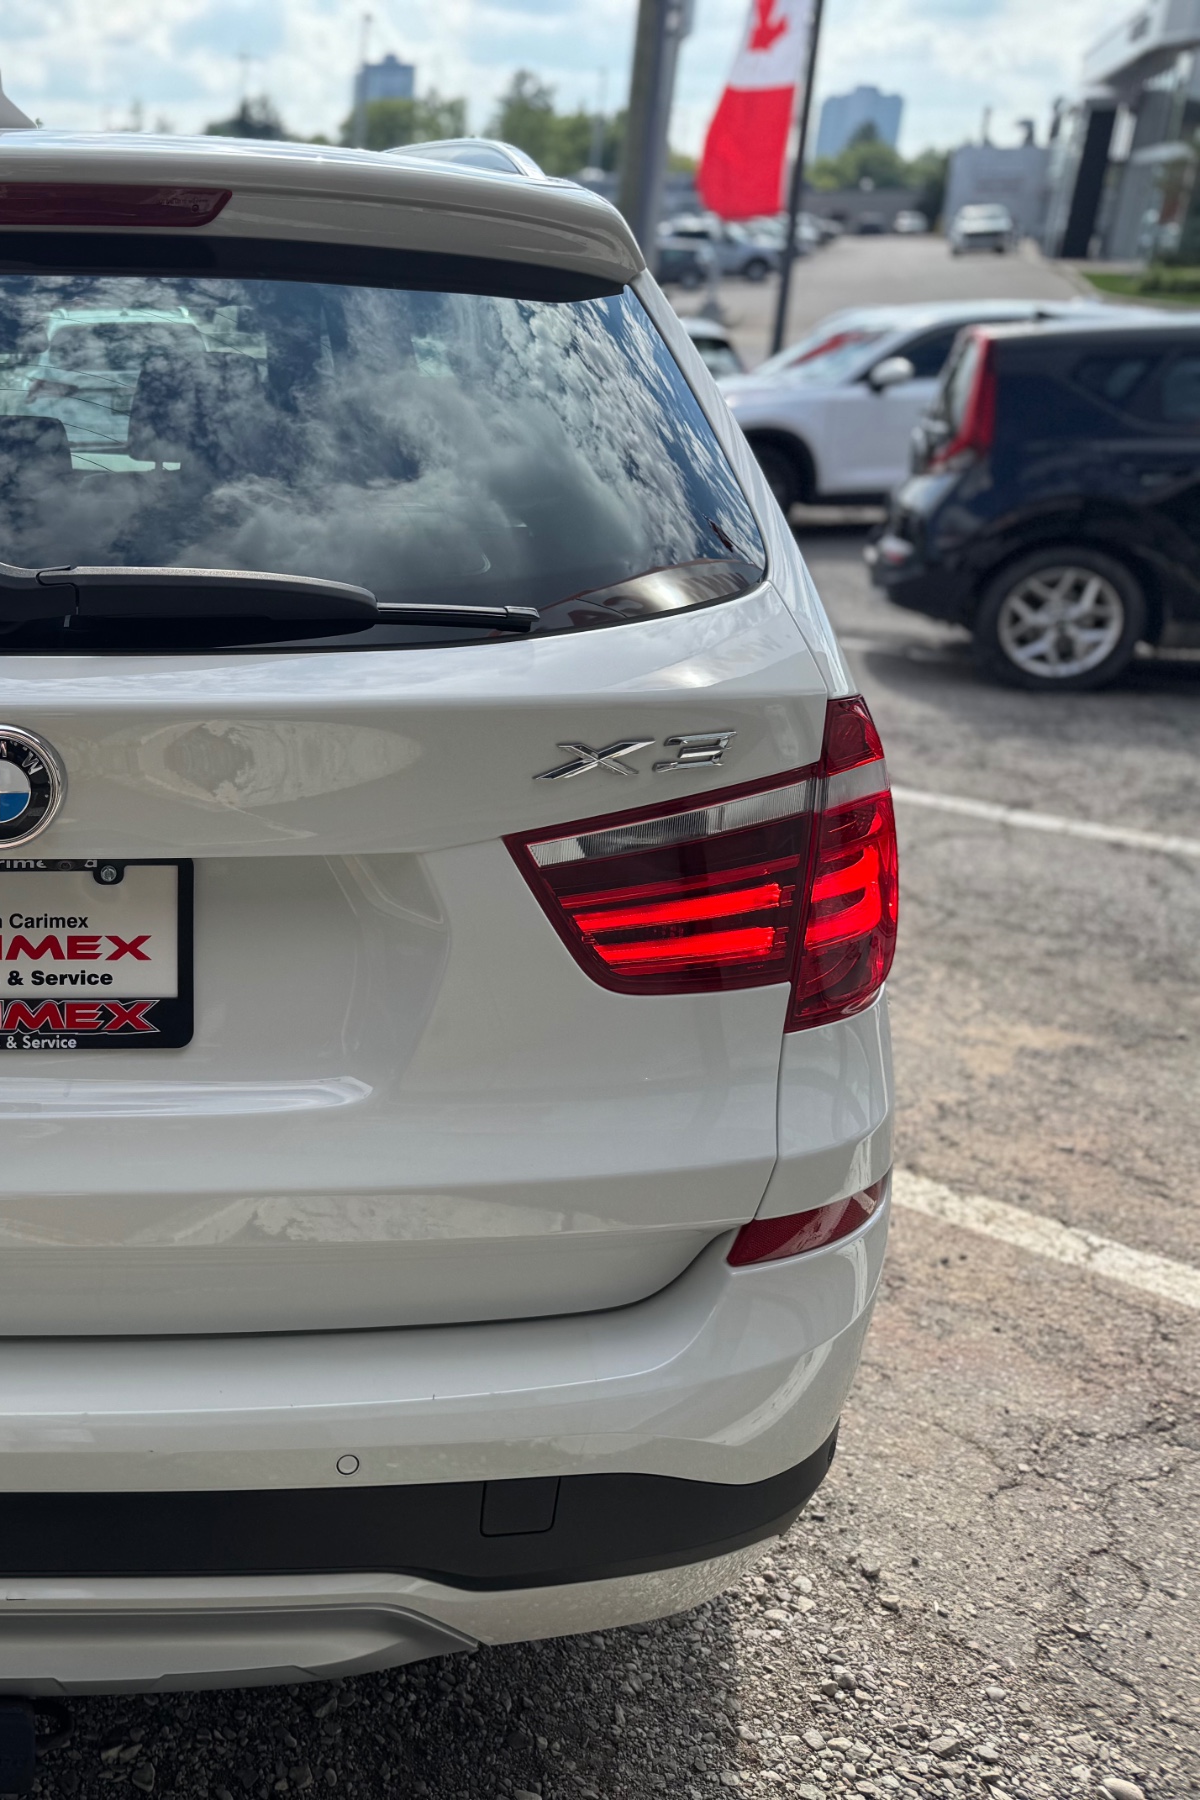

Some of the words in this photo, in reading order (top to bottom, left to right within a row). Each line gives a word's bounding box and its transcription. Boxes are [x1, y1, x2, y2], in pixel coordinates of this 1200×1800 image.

[532, 731, 738, 780] X3
[9, 913, 89, 929] Carimex
[7, 970, 24, 986] &
[31, 970, 113, 986] Service
[6, 1035, 18, 1049] &
[22, 1034, 78, 1049] Service
